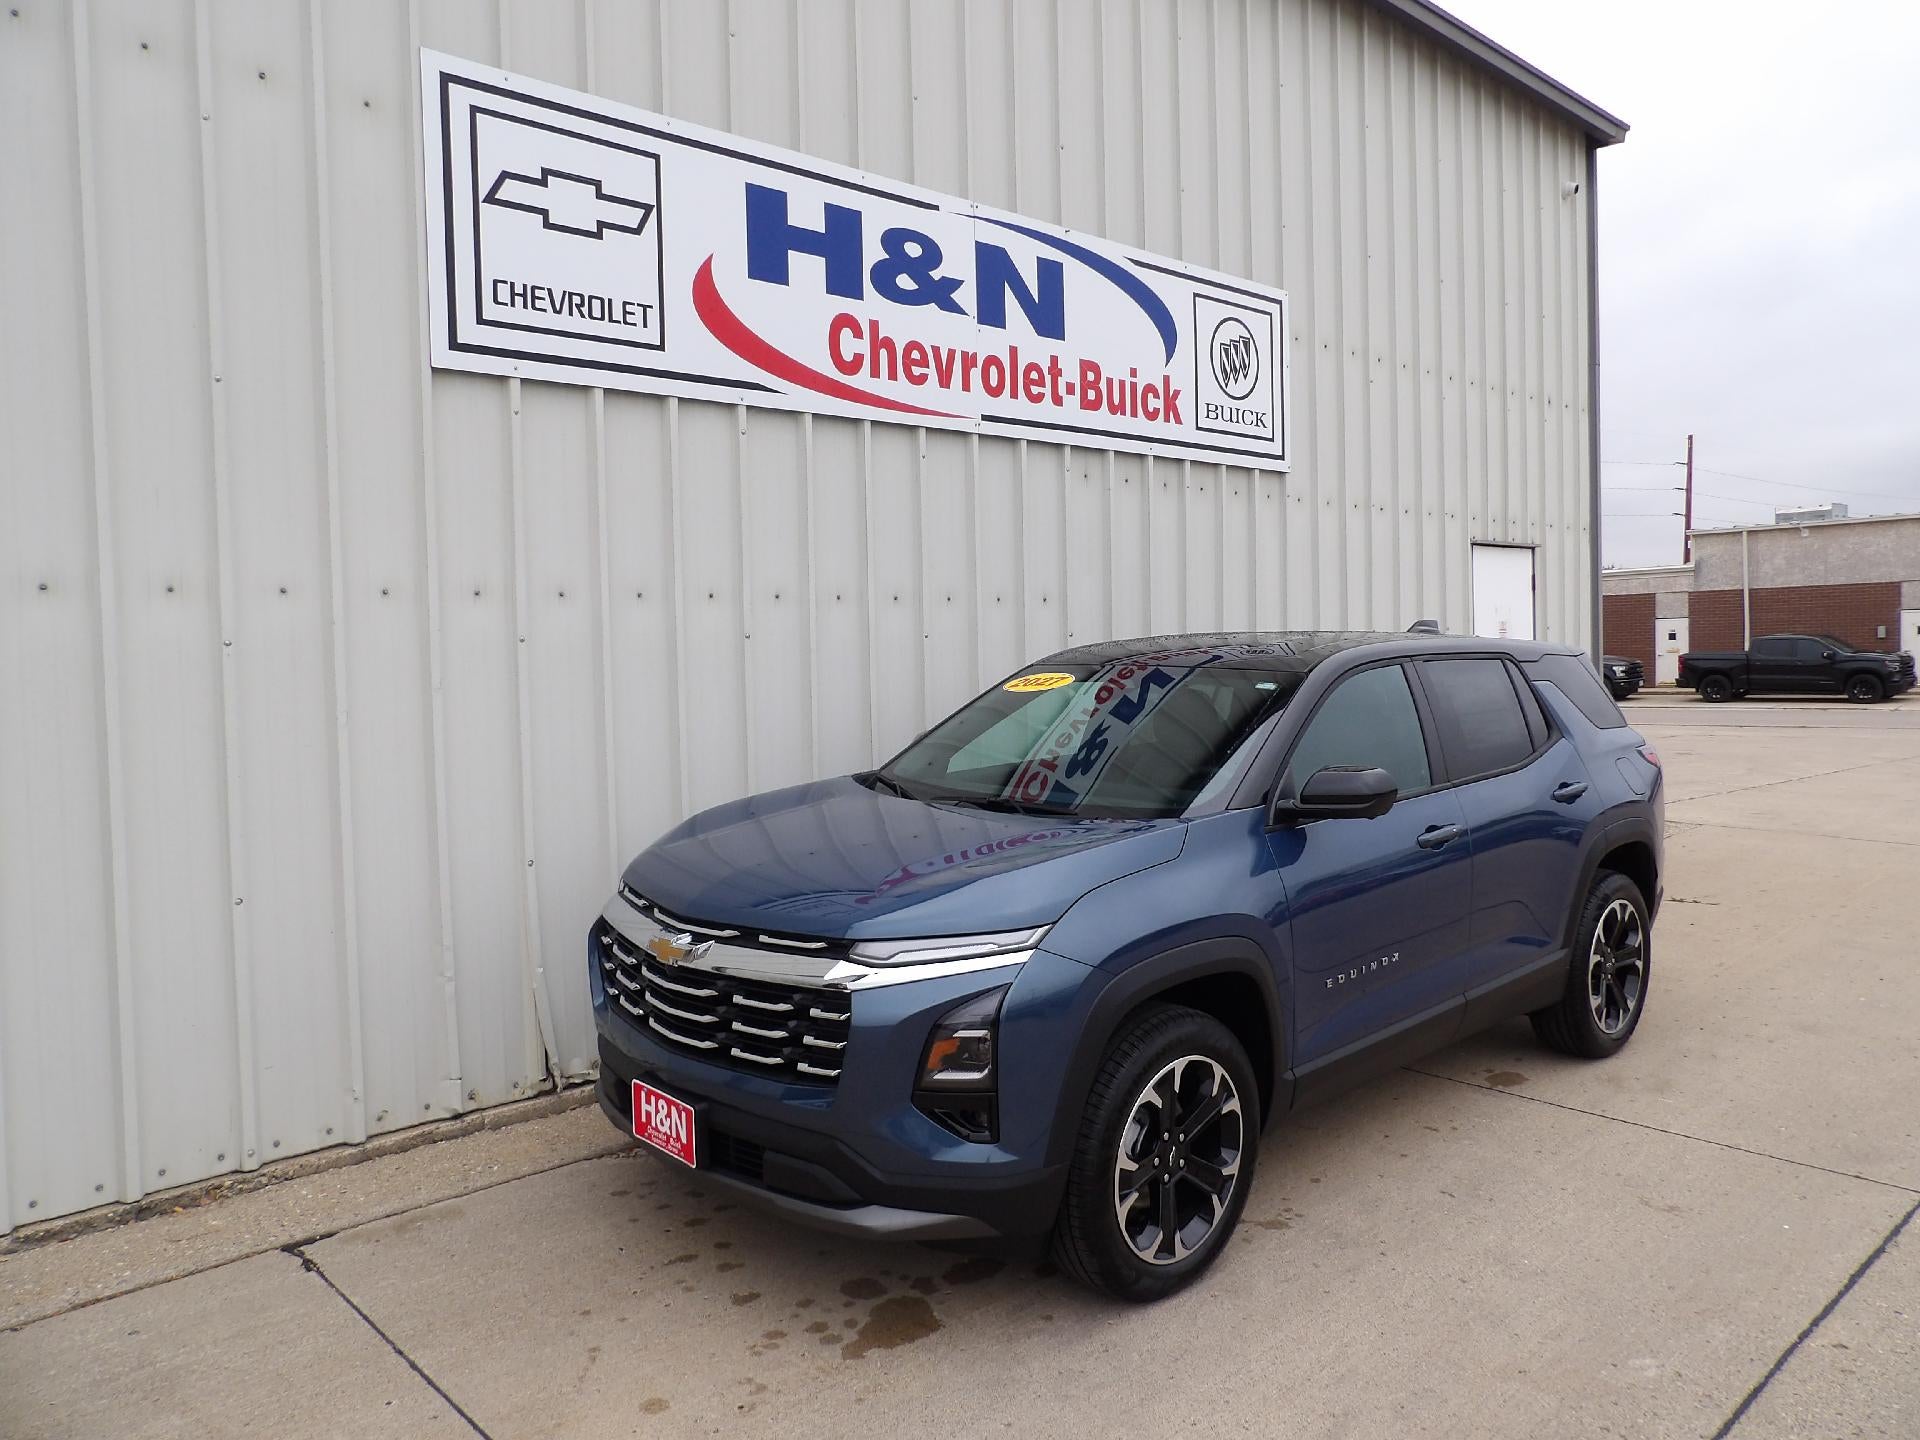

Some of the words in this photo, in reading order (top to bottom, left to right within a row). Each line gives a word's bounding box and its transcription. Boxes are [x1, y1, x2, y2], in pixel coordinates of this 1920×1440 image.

[744, 181, 1066, 342] H&N
[492, 278, 654, 329] CHEVROLET
[828, 312, 1184, 425] Chevrolet-Buick
[1204, 402, 1268, 429] BUICK
[1326, 952, 1399, 989] EQUINOX
[640, 1089, 687, 1145] H&N
